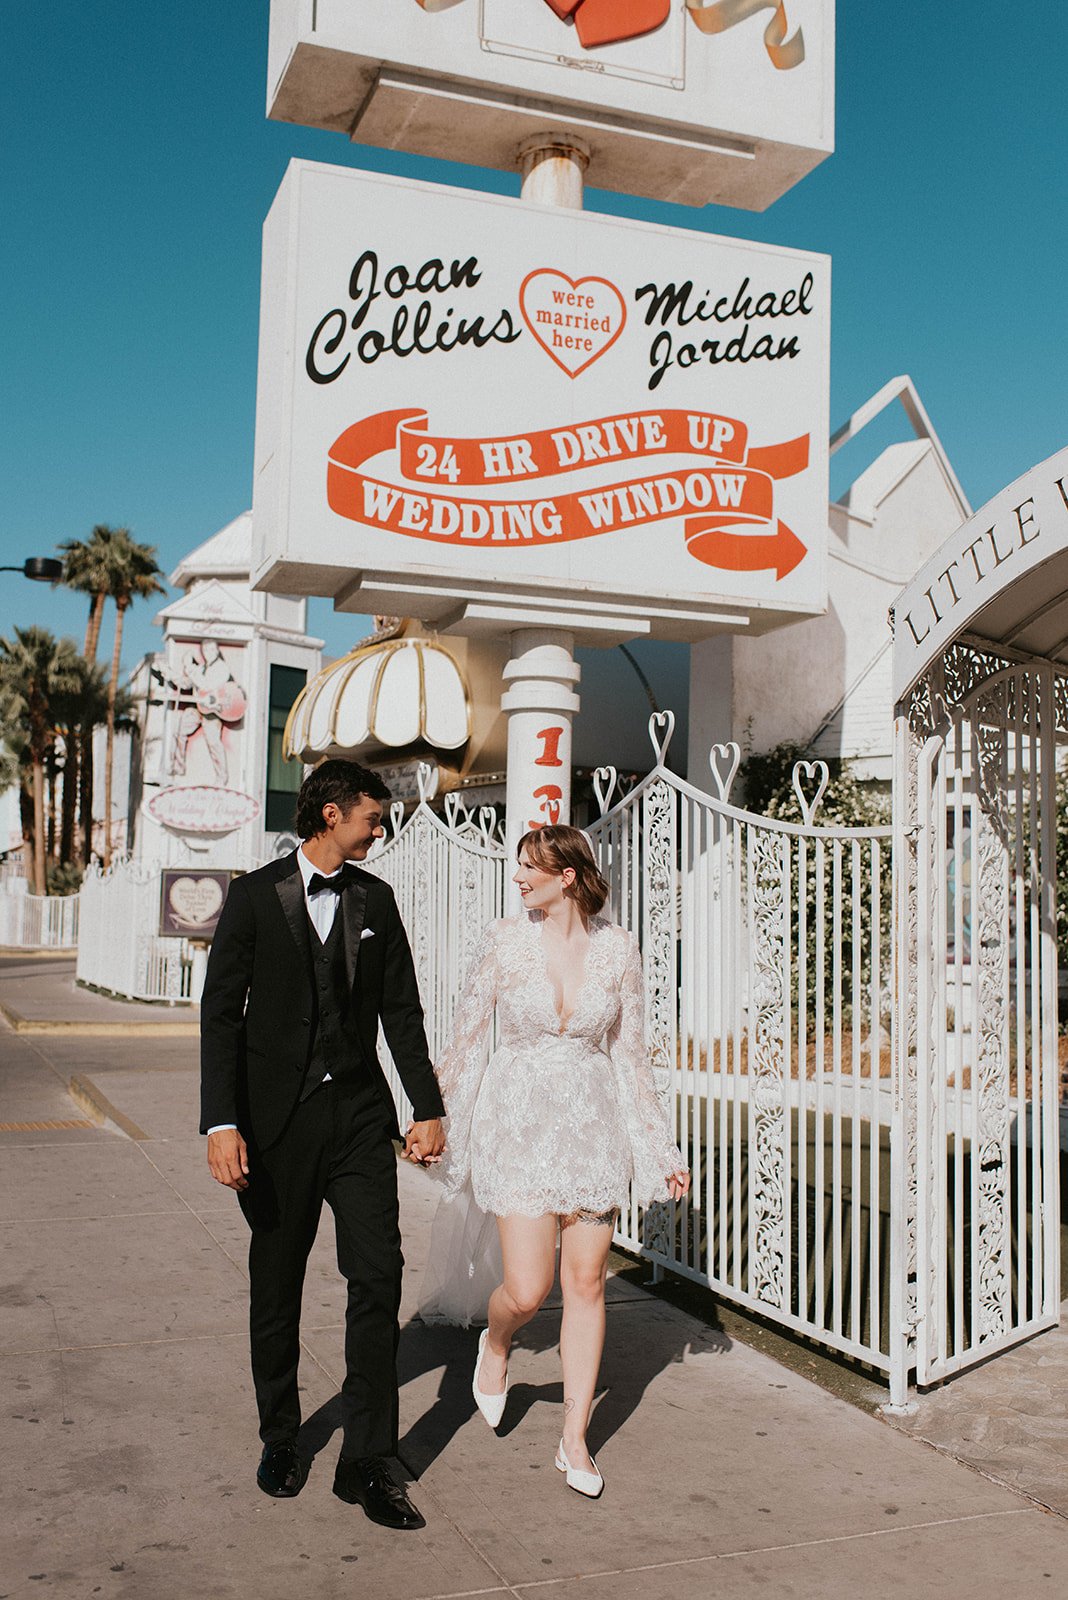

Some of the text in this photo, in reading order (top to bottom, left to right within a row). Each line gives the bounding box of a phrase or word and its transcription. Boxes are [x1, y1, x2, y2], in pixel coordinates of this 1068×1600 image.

[348, 250, 482, 330] Joan
[536, 309, 611, 333] married
[552, 290, 595, 310] were
[635, 271, 814, 327] Michael
[305, 300, 522, 385] Collins
[552, 328, 593, 353] here
[648, 324, 801, 391] Jordan
[416, 414, 735, 483] 24 HR DRIVE UP
[361, 473, 747, 541] WEDDING WINDOW
[903, 496, 1041, 648] LITTLE
